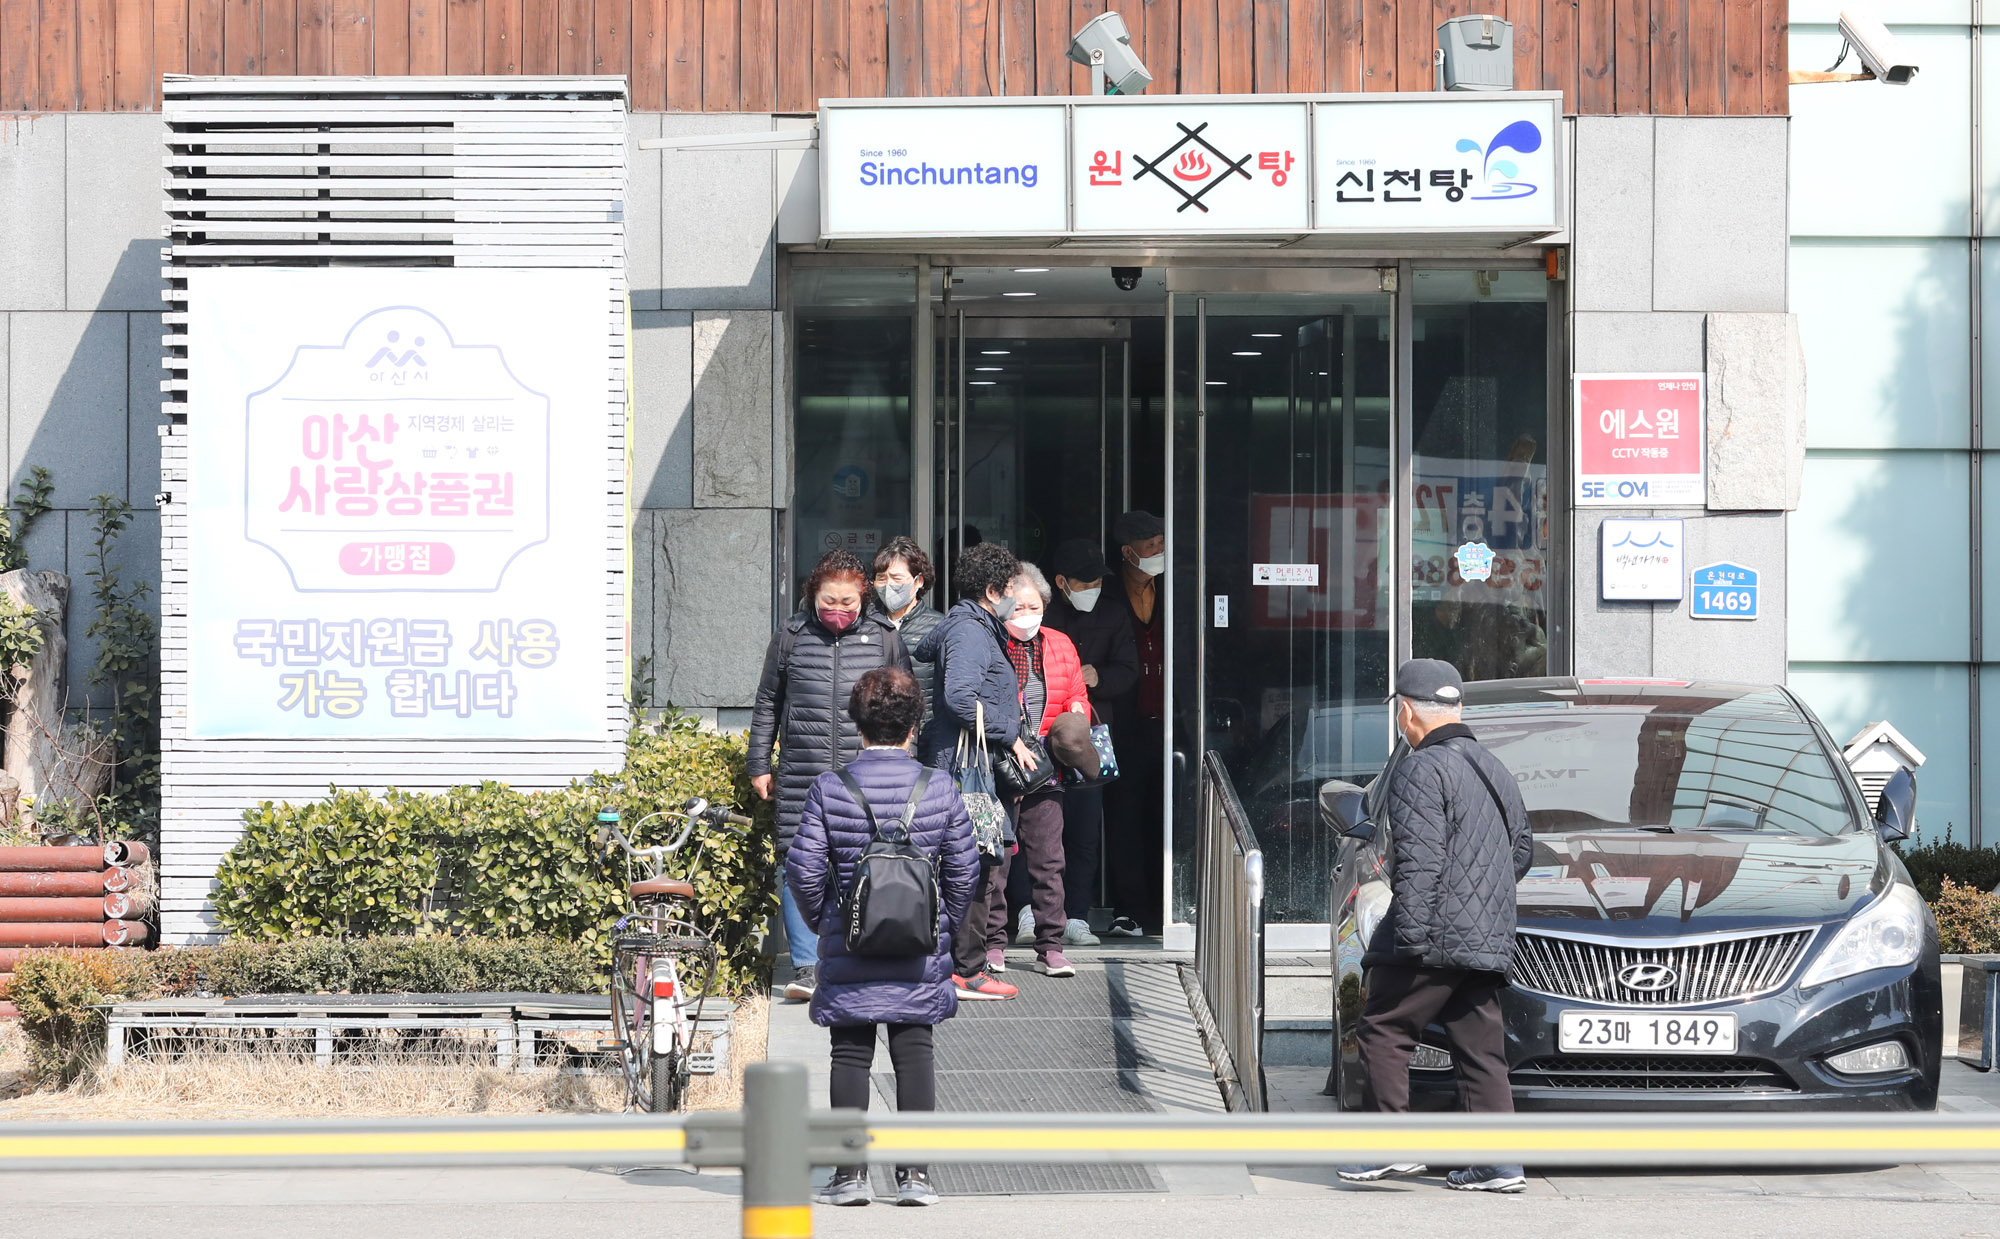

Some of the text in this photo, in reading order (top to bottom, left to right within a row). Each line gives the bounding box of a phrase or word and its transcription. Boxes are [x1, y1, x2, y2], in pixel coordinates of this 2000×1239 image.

[860, 149, 907, 157] Since 1960
[859, 161, 1038, 188] Sinchuntang
[1088, 150, 1295, 187] 원 탕
[1336, 168, 1474, 203] 신천탕
[369, 370, 428, 386] 아산시
[1657, 382, 1697, 391] 언제나 안심
[407, 414, 515, 433] 지역경제 살리는
[1599, 408, 1679, 440] 에스원
[302, 413, 400, 471] 아산
[1612, 447, 1669, 458] CCTV 작동중
[278, 464, 515, 517] 사랑상품권
[1581, 481, 1648, 498] SECOM
[360, 544, 431, 571] 가맹점
[1276, 568, 1313, 582] 머리조심
[1700, 591, 1751, 611] 1469
[234, 619, 560, 669] 국민지원금 사용
[278, 669, 517, 719] 가능 합니다
[1578, 1018, 1719, 1046] 23마 1849
